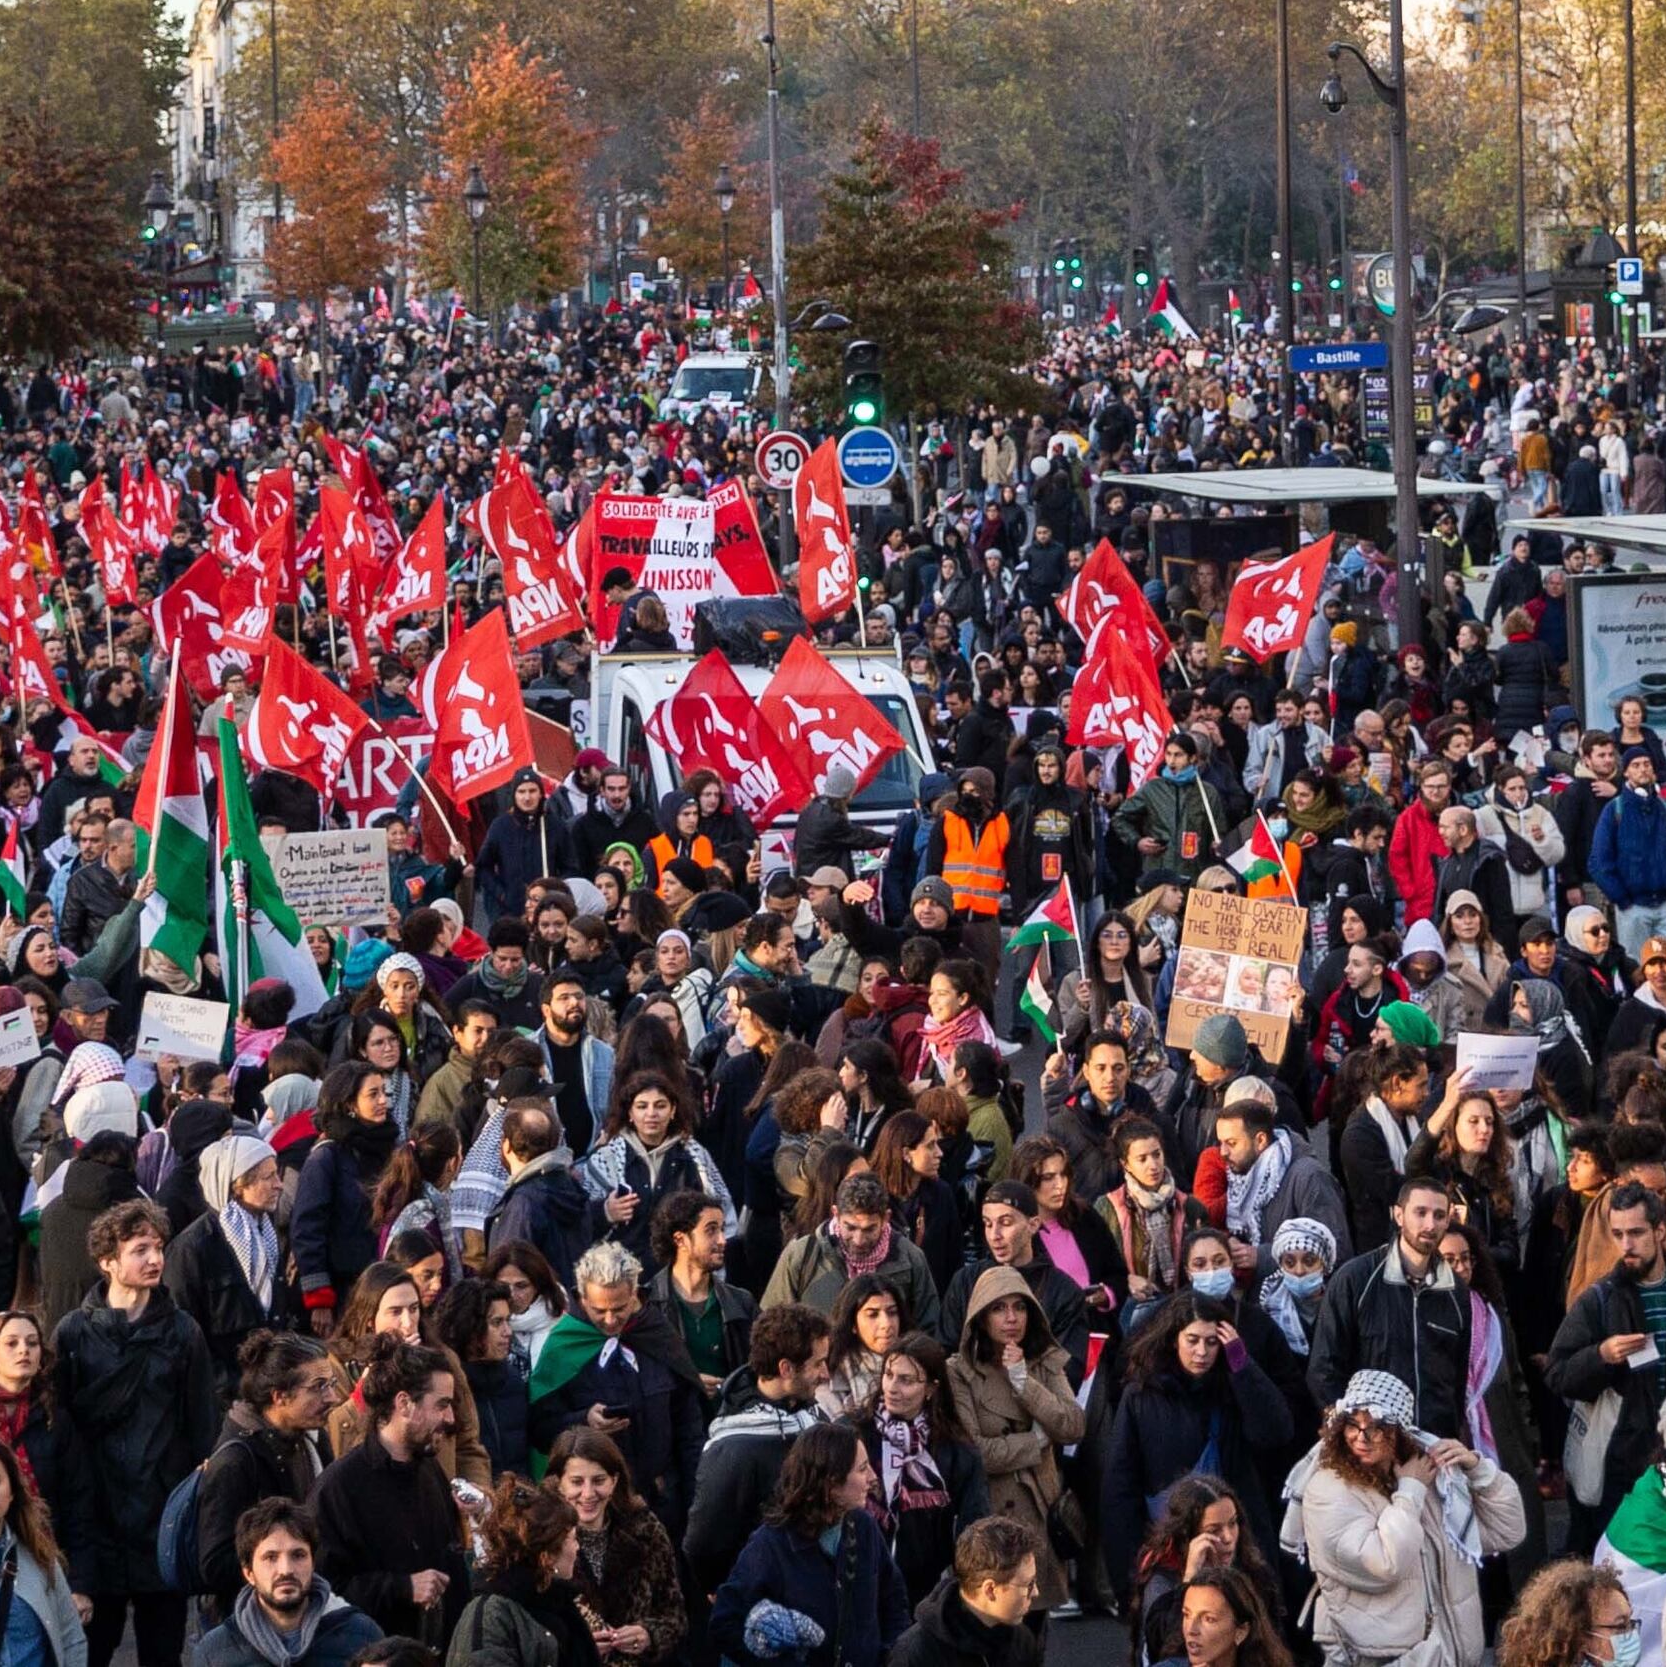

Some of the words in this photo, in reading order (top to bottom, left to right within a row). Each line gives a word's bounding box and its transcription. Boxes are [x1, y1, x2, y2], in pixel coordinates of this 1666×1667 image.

[1375, 269, 1396, 288] BU
[1316, 350, 1361, 364] Bastille
[769, 449, 800, 472] 30
[604, 501, 673, 519] SOLIDARITÉ
[676, 506, 698, 520] AVEC
[601, 535, 699, 558] TRAVAILLEURS
[1193, 893, 1213, 908] NO
[1220, 895, 1303, 924] HALLOWEEN
[1214, 911, 1241, 926] THIS
[1187, 919, 1210, 934] THE
[1215, 925, 1257, 939] HORROR
[1218, 937, 1237, 951] IS
[1248, 941, 1287, 961] REAL
